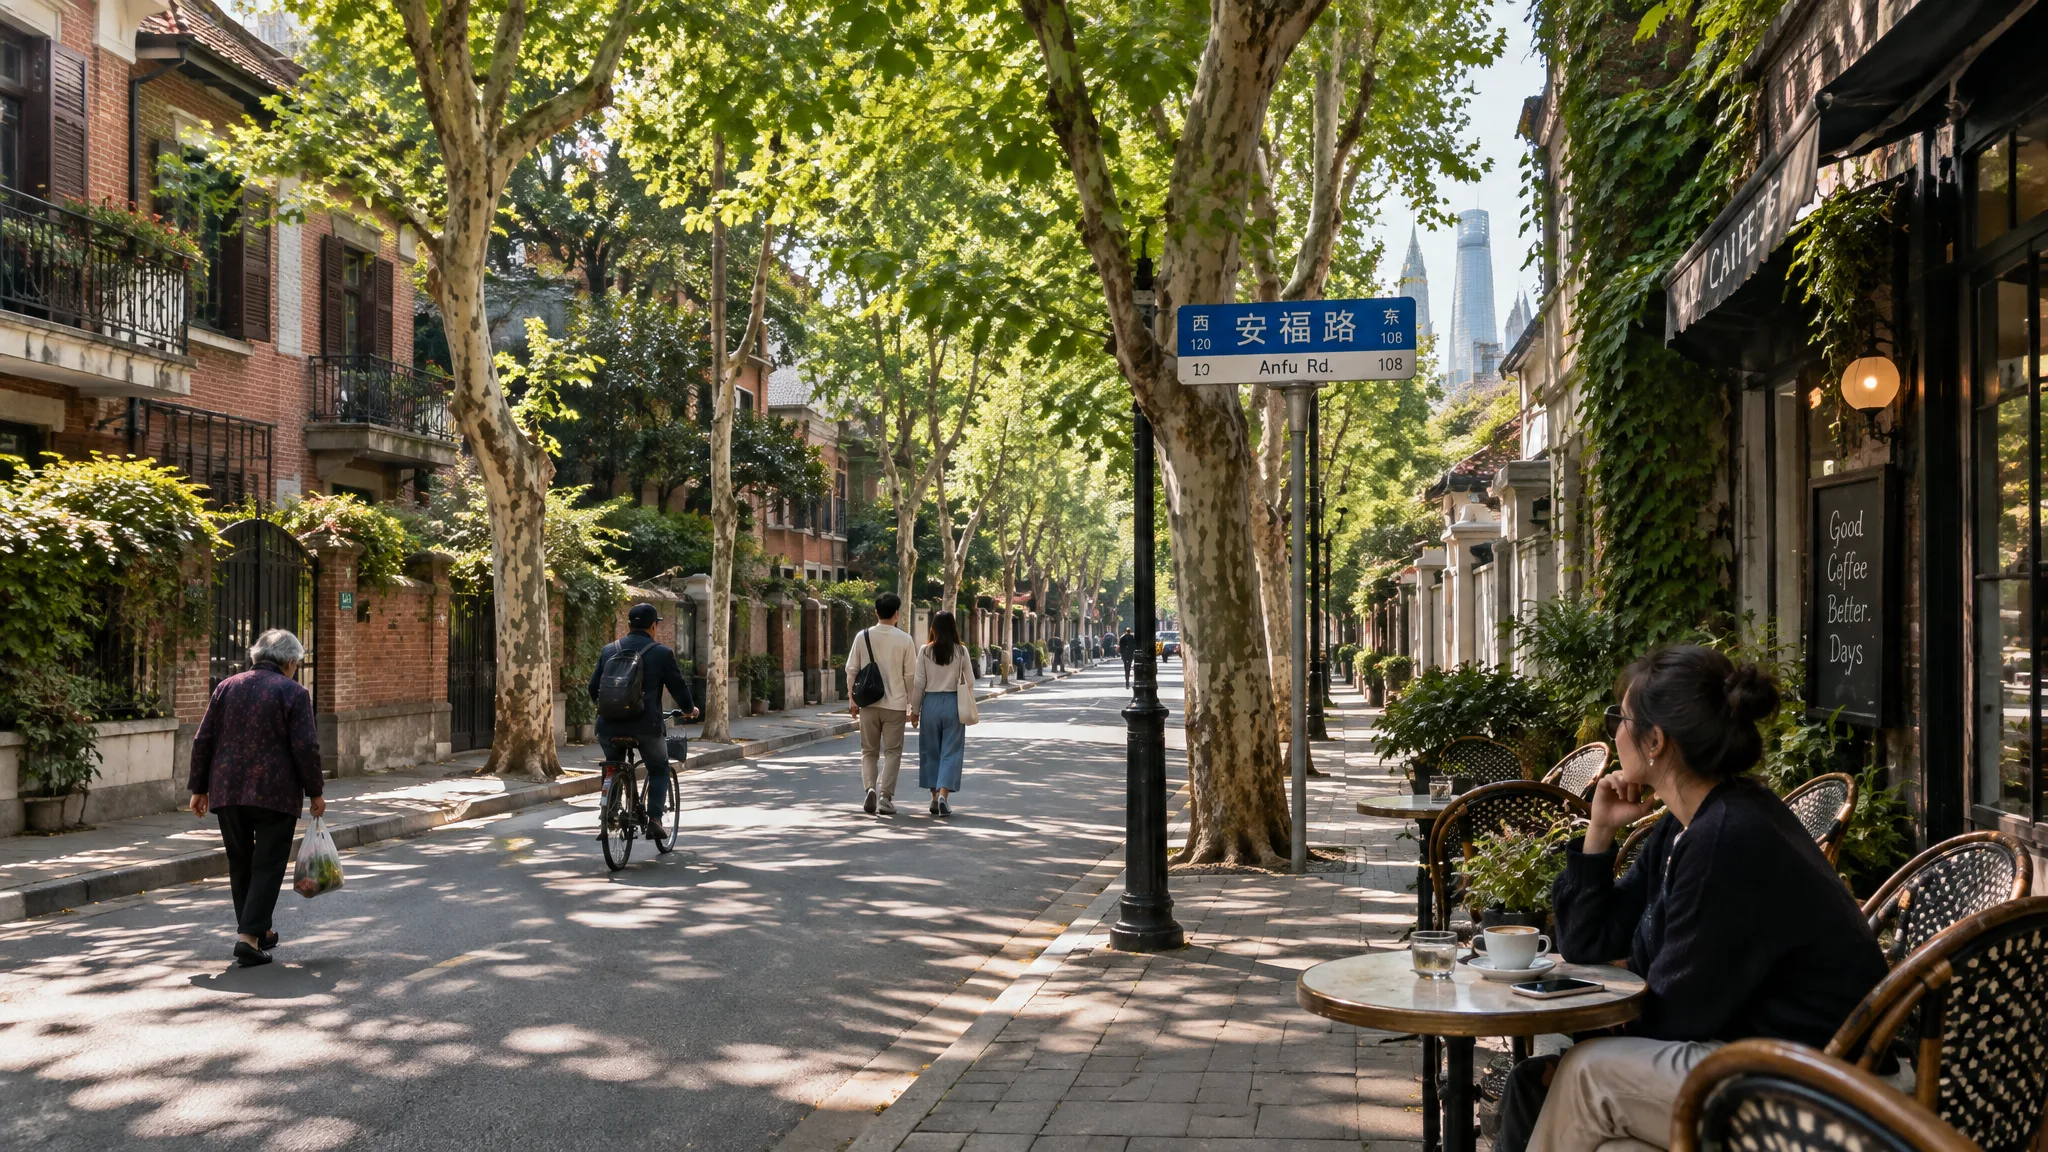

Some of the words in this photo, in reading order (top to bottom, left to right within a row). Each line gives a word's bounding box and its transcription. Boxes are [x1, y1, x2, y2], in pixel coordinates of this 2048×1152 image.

[1193, 314, 1209, 332] 西
[1382, 308, 1401, 326] 东
[1235, 309, 1356, 346] 安福路
[1191, 338, 1211, 351] 120
[1381, 331, 1403, 344] 108
[1259, 359, 1298, 375] Anfu
[1307, 358, 1334, 374] Rd.
[1378, 357, 1403, 372] 108
[1829, 509, 1864, 549] Good
[1829, 633, 1863, 674] Days
